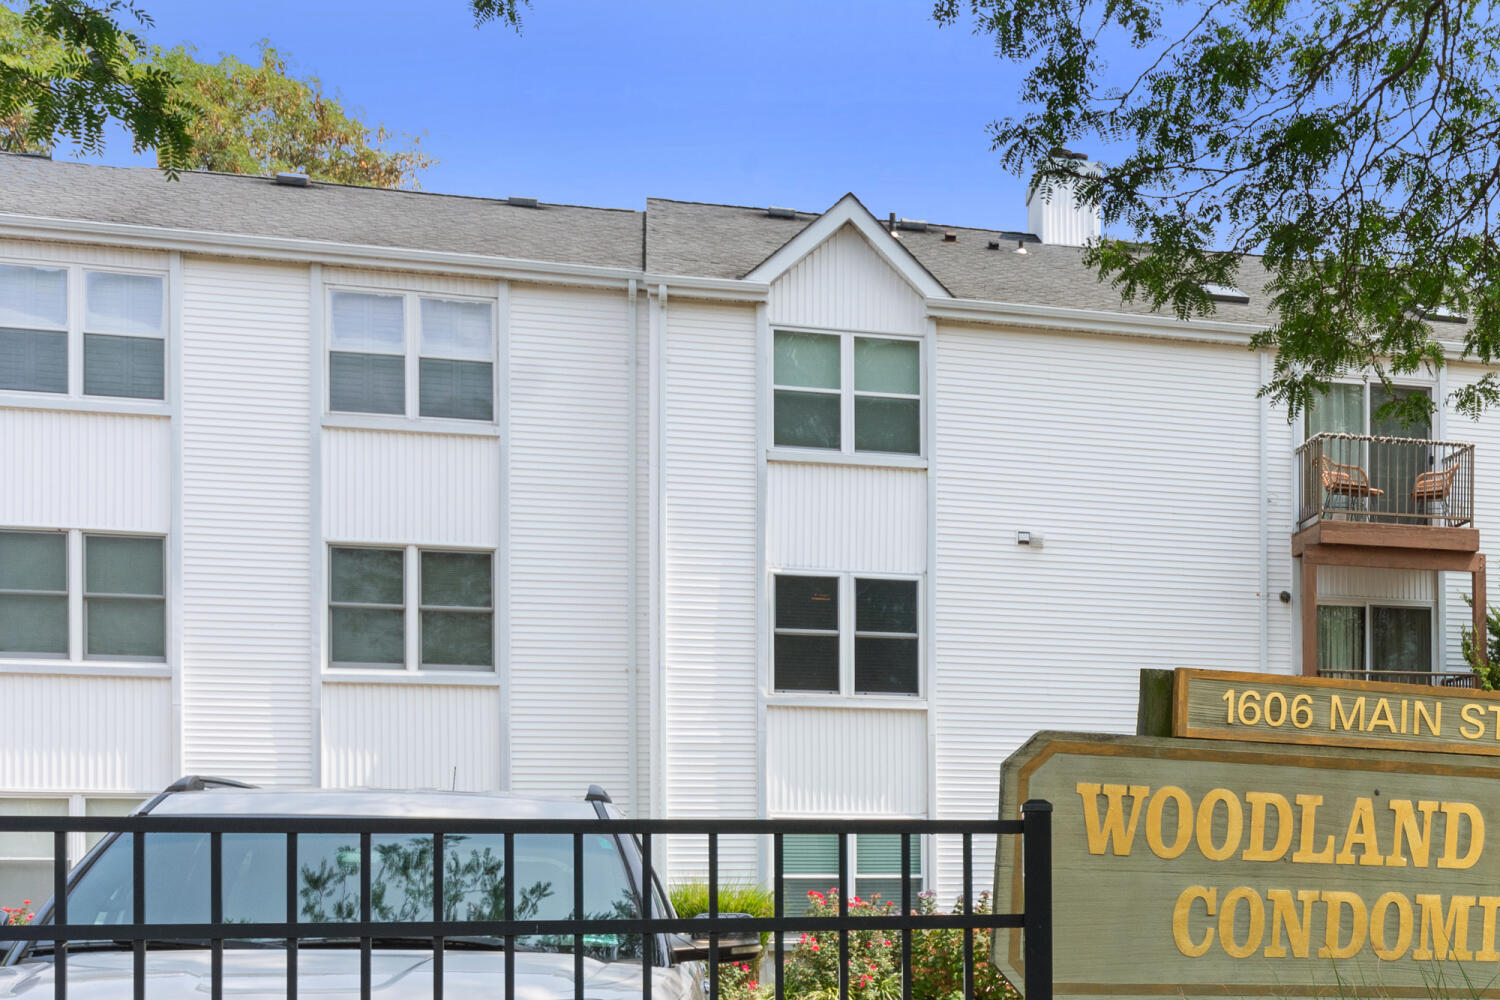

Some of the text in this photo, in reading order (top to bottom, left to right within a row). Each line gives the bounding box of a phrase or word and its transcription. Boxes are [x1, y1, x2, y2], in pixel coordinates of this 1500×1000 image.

[1222, 688, 1312, 730] 1606
[1329, 694, 1443, 737] MAIN
[1076, 782, 1485, 868] WOODLAND
